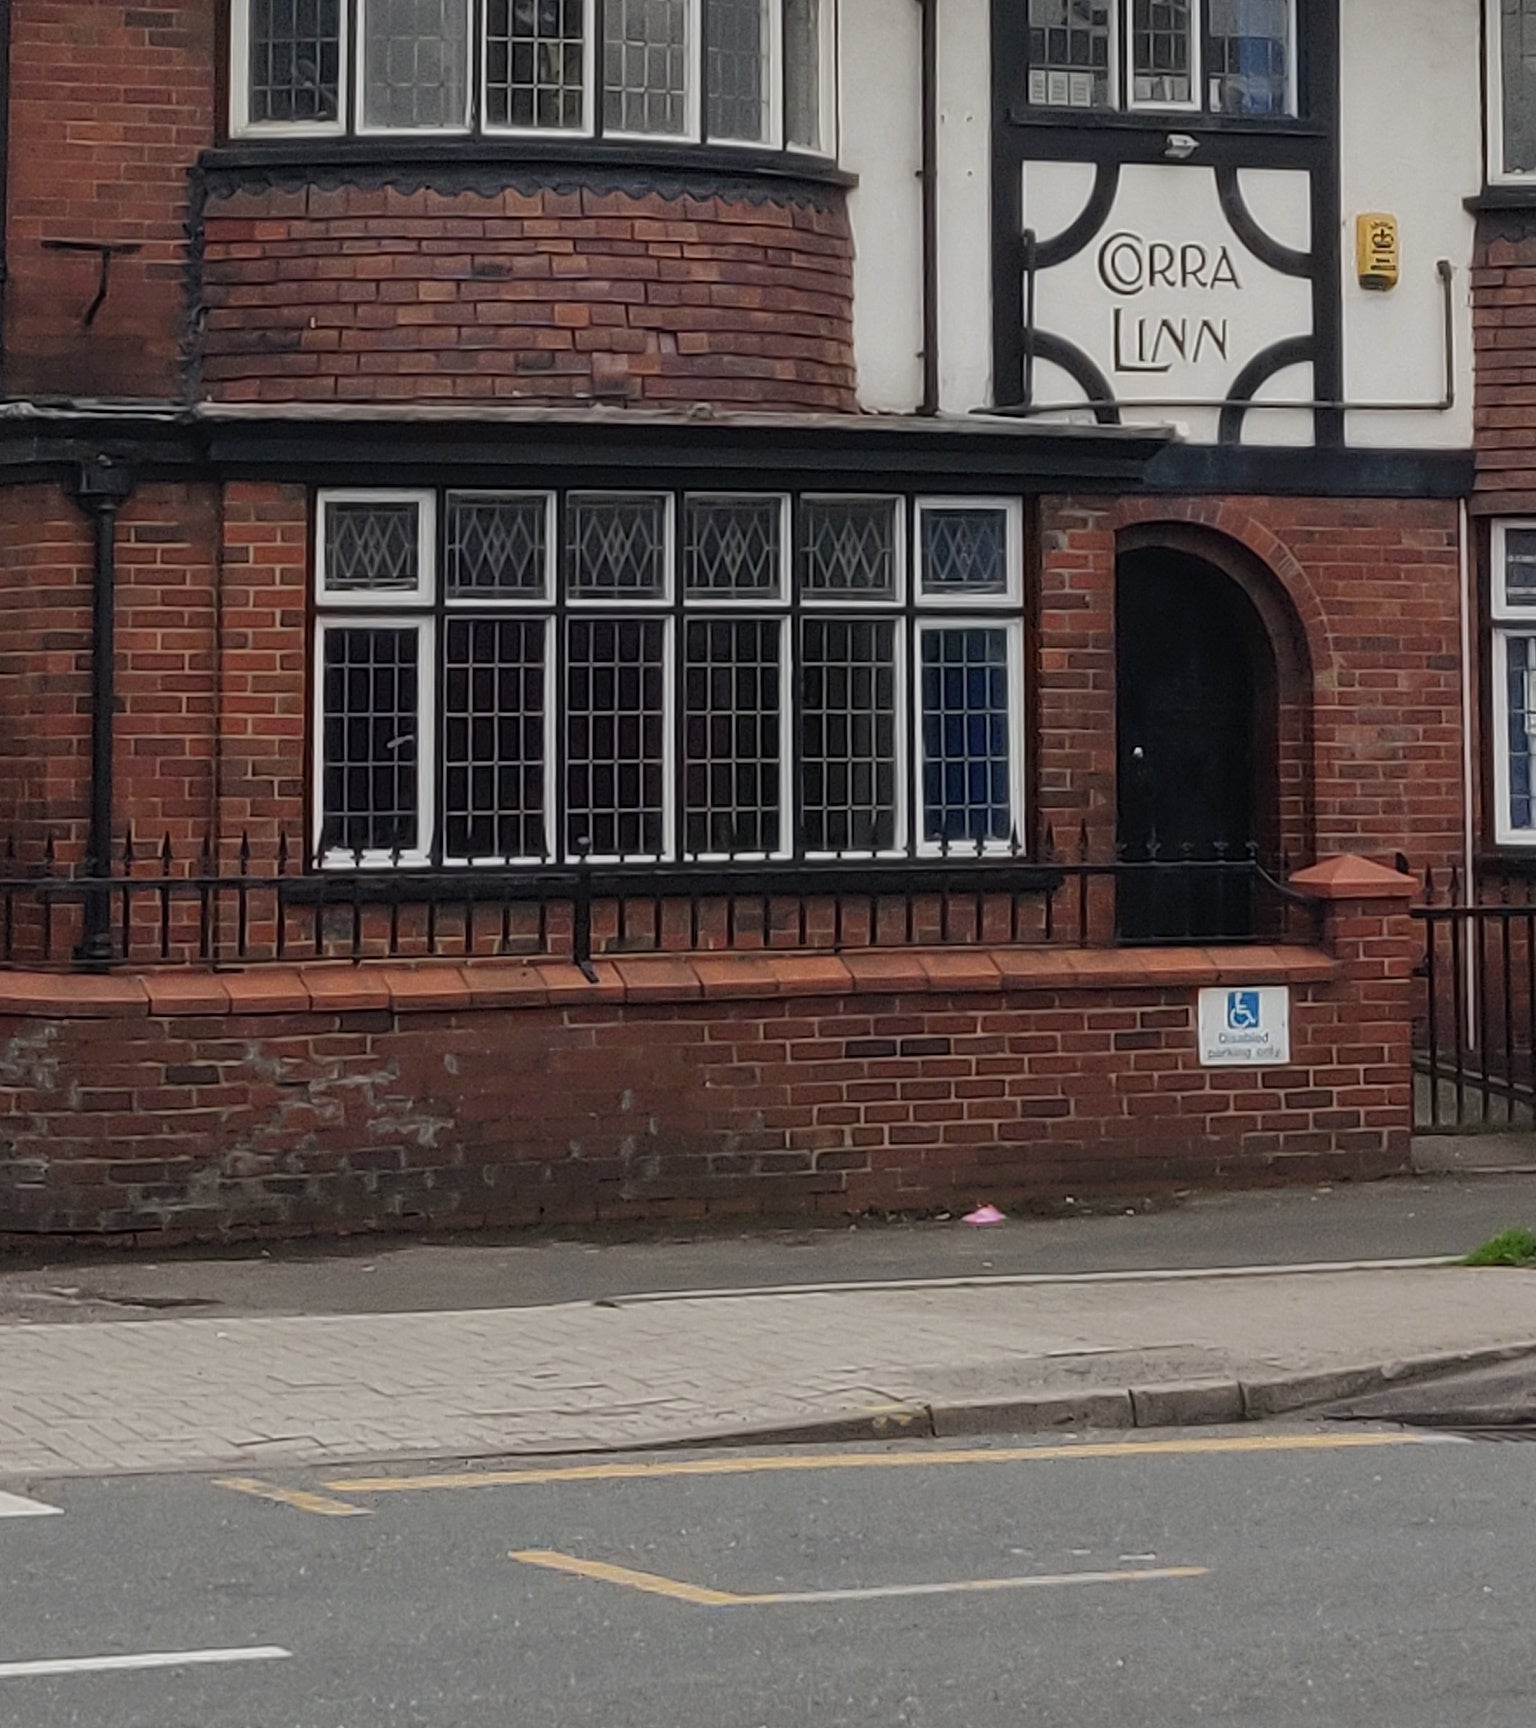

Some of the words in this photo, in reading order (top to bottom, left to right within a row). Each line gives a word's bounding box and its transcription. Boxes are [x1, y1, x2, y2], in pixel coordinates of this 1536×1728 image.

[1098, 232, 1243, 295] CORRA
[1113, 307, 1229, 372] LINN
[1219, 1032, 1269, 1044] Disabled
